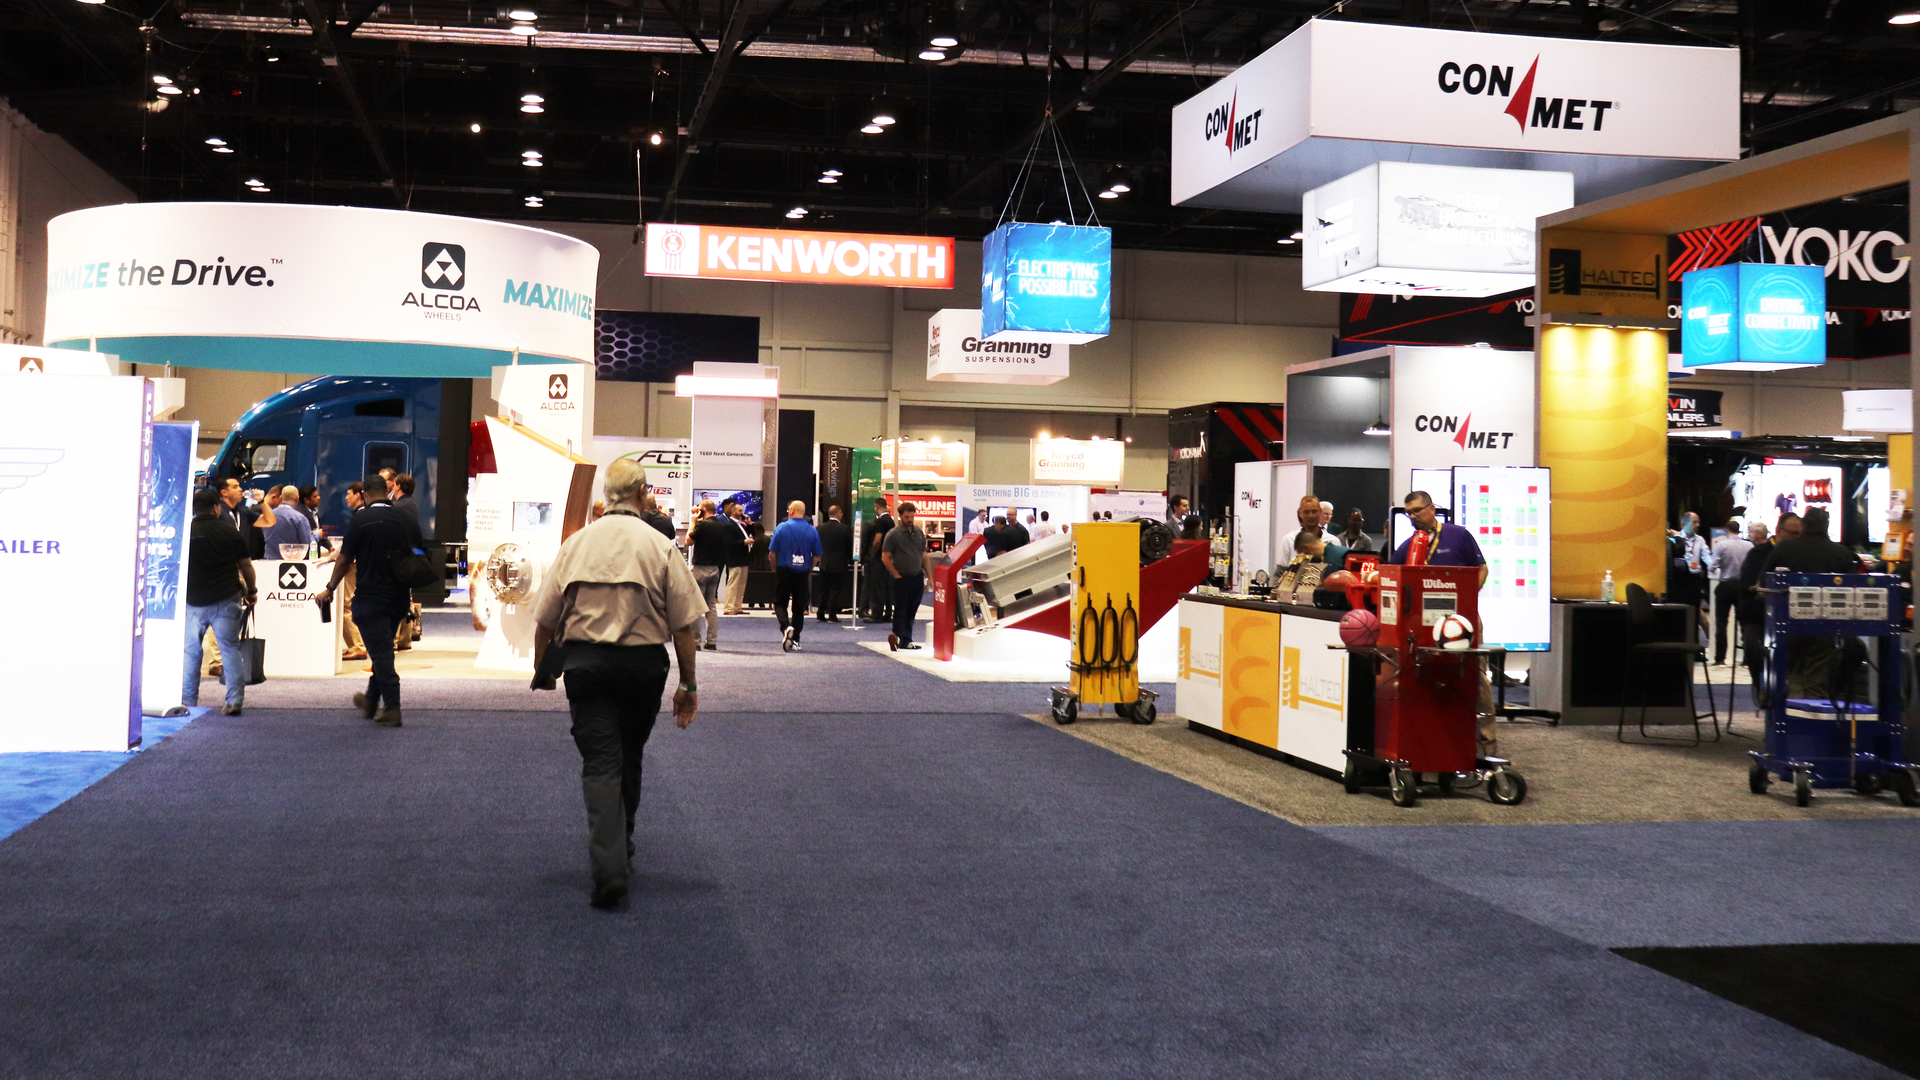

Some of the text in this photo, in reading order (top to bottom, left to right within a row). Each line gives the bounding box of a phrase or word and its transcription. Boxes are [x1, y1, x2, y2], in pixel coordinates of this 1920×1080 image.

[706, 234, 946, 280] KENWORTH
[118, 259, 165, 287] the
[1018, 259, 1099, 280] ELECTRIFYING
[1582, 268, 1655, 286] HALTEC
[1018, 277, 1097, 298] POSSIBILITIES
[401, 291, 481, 312] ALCOA
[503, 278, 593, 321] MAXIMIZE
[1760, 297, 1805, 314] DRIVING
[423, 311, 462, 322] WHEELS
[1745, 313, 1821, 331] CONNECTIVITY
[961, 336, 1053, 359] Granning
[965, 356, 1036, 364] SUSPENSIONS
[540, 401, 576, 411] ALCOA
[899, 453, 926, 461] DUCING
[1038, 458, 1085, 471] Granning
[667, 471, 690, 479] CUS
[973, 488, 1012, 497] SOMETHING
[1013, 487, 1030, 498] BIG
[1040, 490, 1067, 498] COMING
[1422, 578, 1457, 589] Wilson
[266, 592, 317, 602] ALCOA
[1300, 674, 1341, 702] HALTEC
